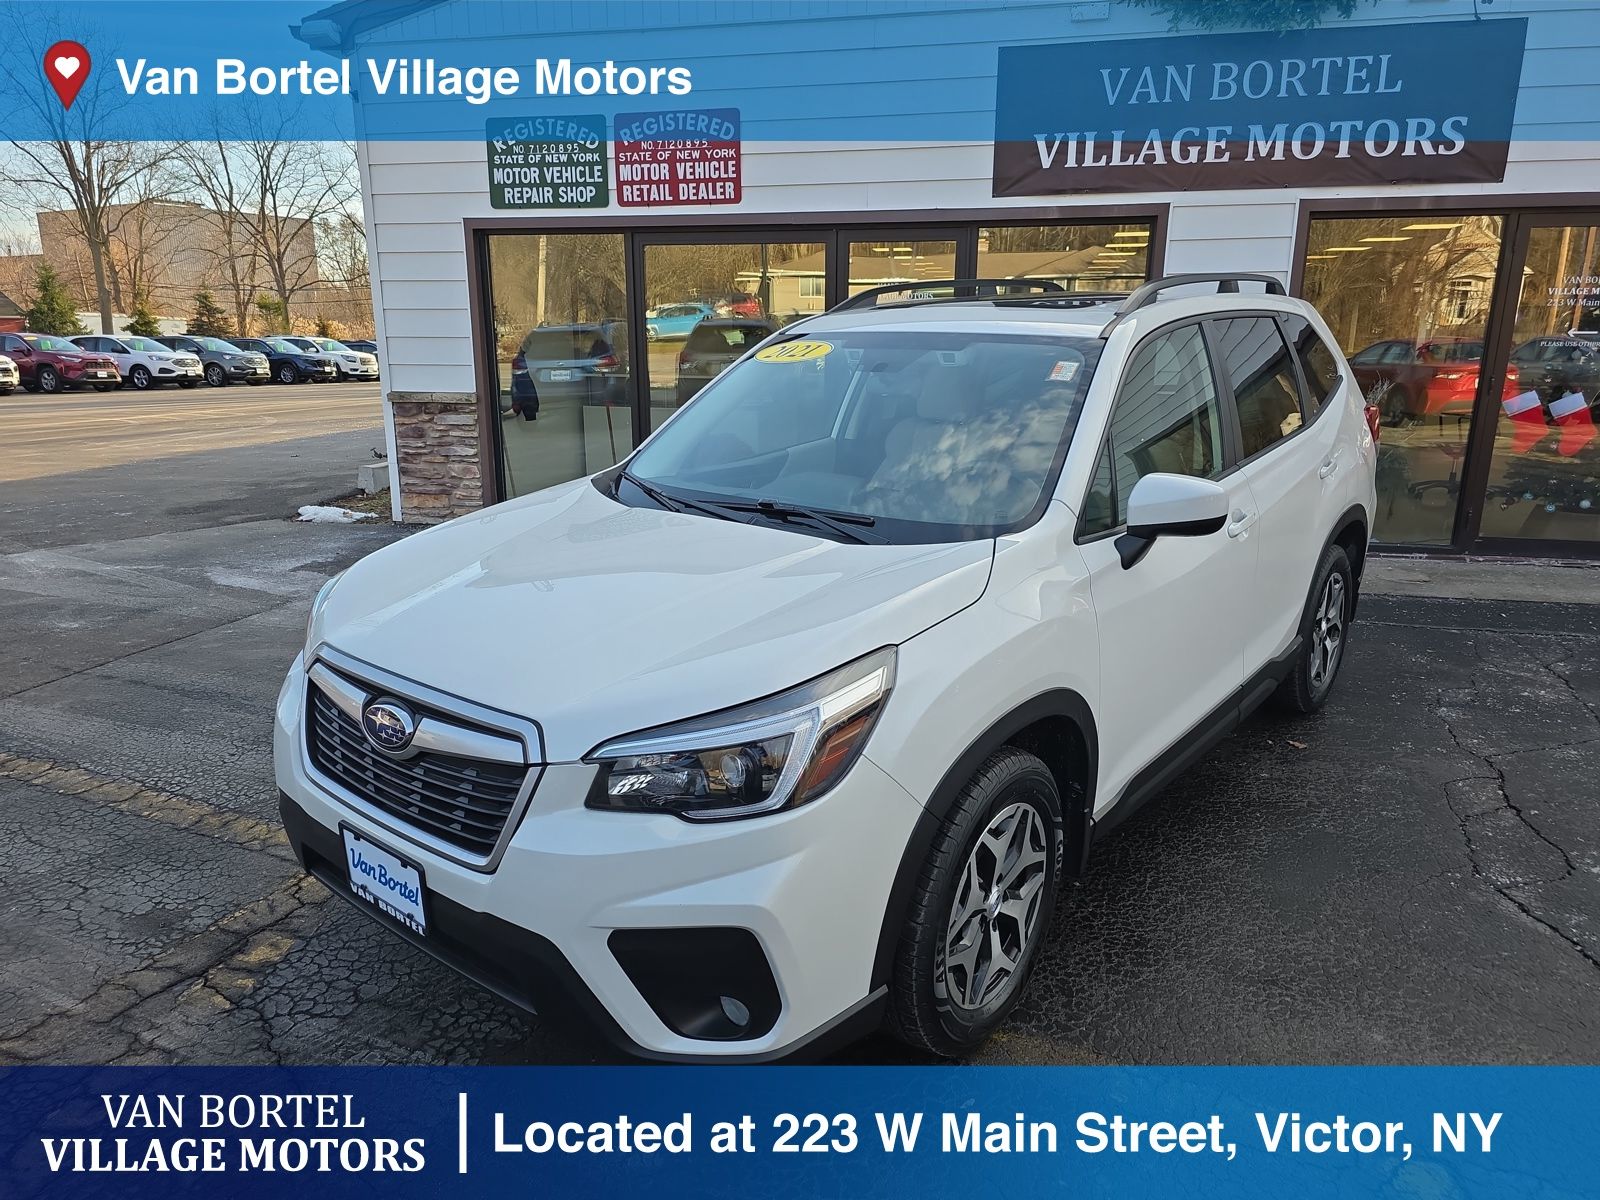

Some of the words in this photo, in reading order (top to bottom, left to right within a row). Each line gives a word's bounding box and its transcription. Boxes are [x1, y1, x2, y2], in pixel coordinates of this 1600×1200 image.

[1099, 64, 1196, 106] VAN
[1210, 54, 1403, 101] BORTEL
[492, 118, 600, 153] REGISTERED
[619, 112, 735, 146] REGISTERED
[528, 143, 580, 155] 7120895
[641, 141, 655, 150] NO.
[657, 138, 708, 149] 7120895
[1033, 125, 1233, 169] VILLAGE
[1244, 115, 1469, 163] MOTORS
[493, 155, 525, 165] STATE
[545, 154, 568, 164] NEW
[571, 152, 601, 163] YORK
[619, 152, 653, 162] STATE
[657, 151, 672, 160] OF
[676, 150, 700, 160] NEW
[705, 148, 736, 159] YORK
[493, 167, 540, 185] MOTOR
[543, 165, 603, 184] VEHICLE
[619, 163, 670, 182] MOTOR
[676, 160, 737, 180] VEHICLE
[504, 187, 554, 204] REPAIR
[558, 185, 596, 203] SHOP
[622, 183, 673, 202] RETAIL
[679, 181, 735, 200] DEALER
[1563, 275, 1582, 284] VAN
[1548, 287, 1590, 295] VILLAGE
[1566, 298, 1577, 307] W
[1579, 298, 1600, 307] Main
[763, 344, 823, 359] 2021
